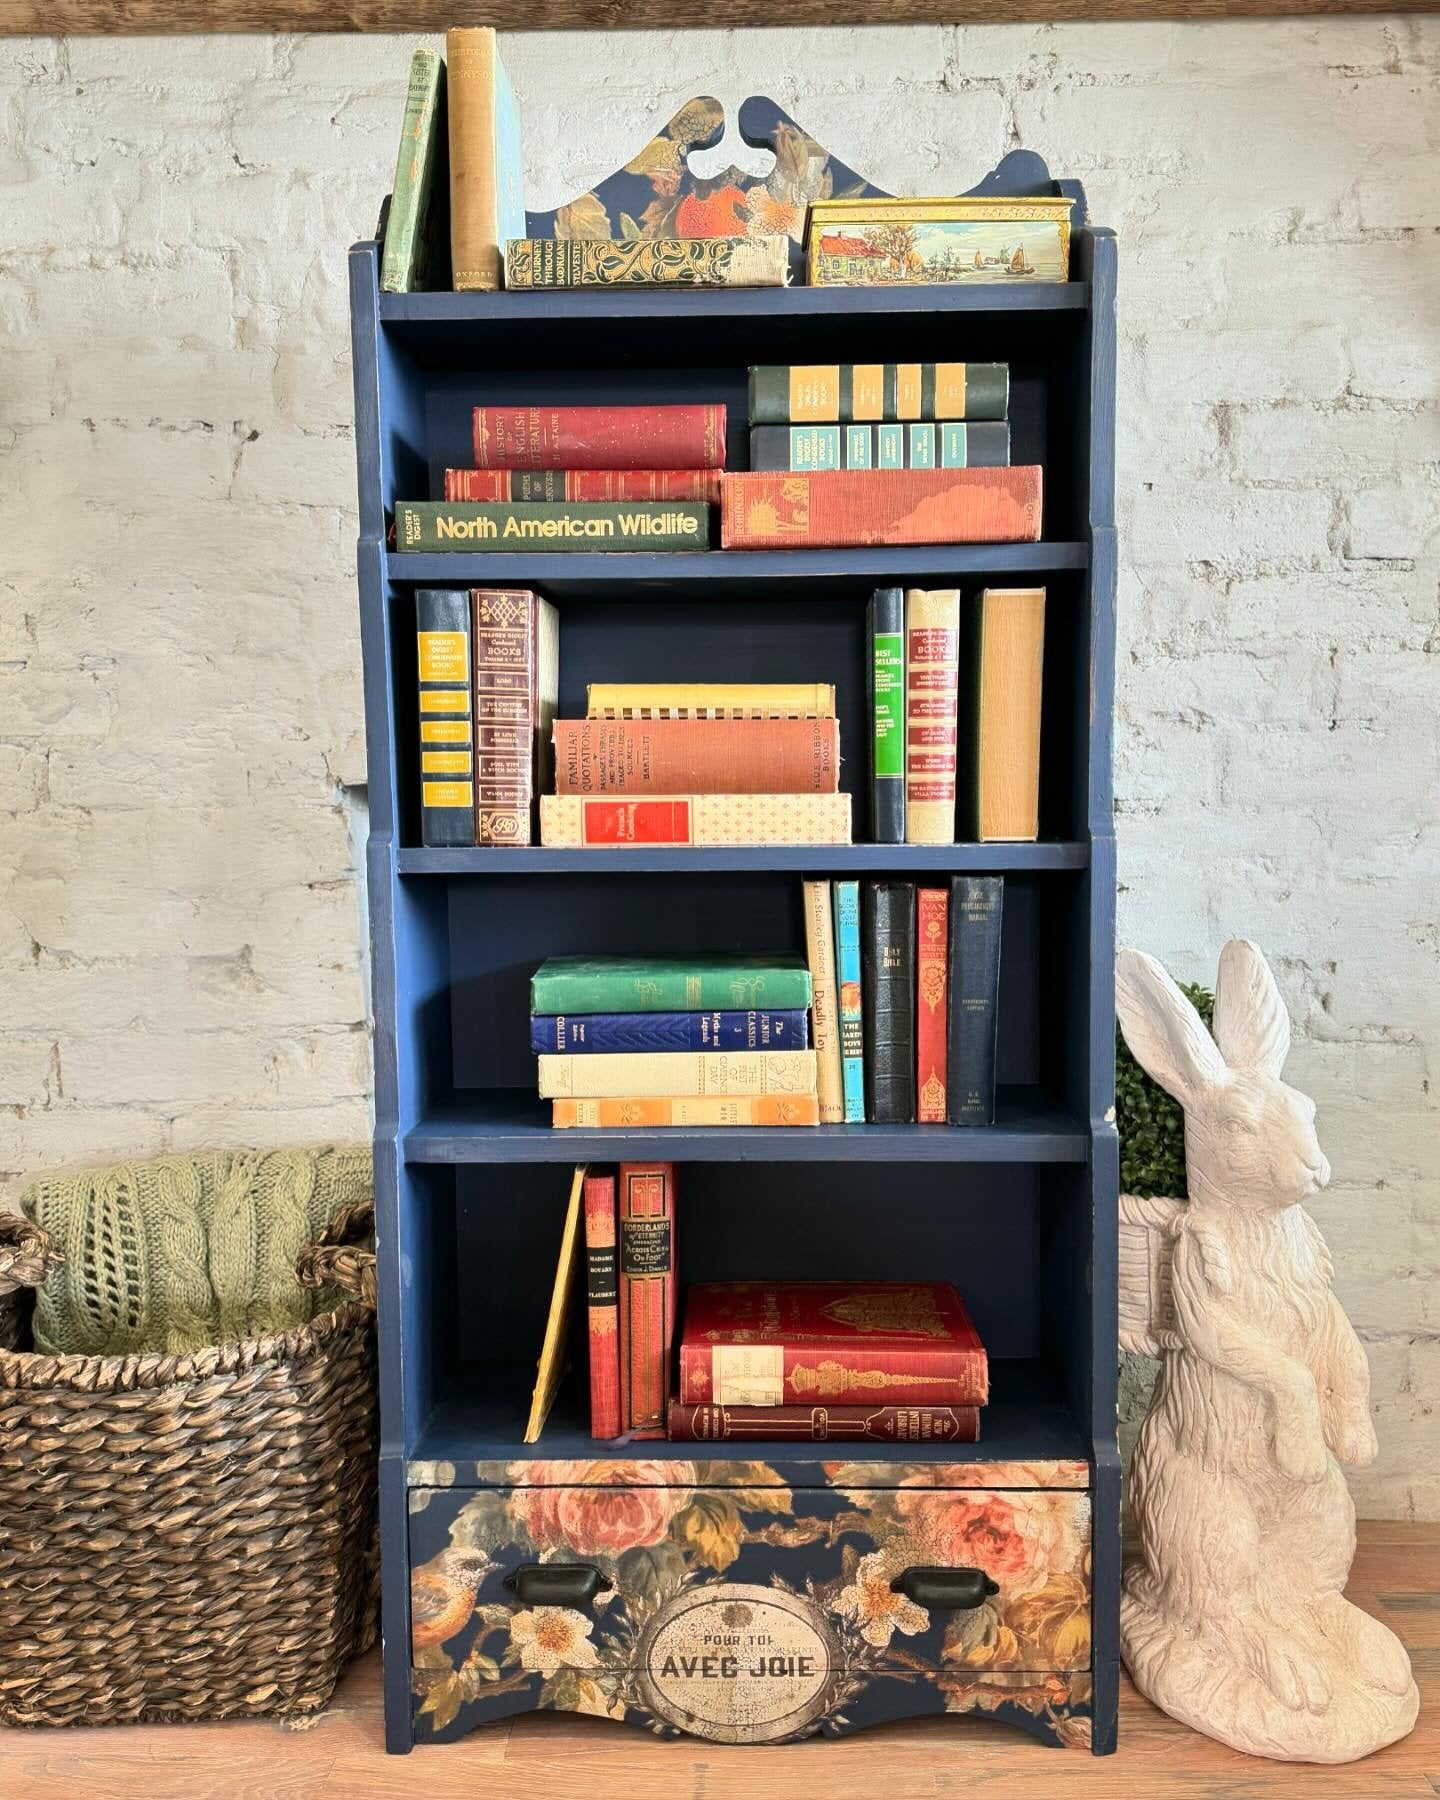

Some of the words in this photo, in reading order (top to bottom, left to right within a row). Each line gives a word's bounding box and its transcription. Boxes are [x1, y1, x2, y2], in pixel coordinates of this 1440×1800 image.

[532, 239, 545, 285] JOURNEYS
[495, 414, 505, 460] HISTORY
[514, 411, 527, 464] ENGLISH
[522, 471, 531, 500] POEMS
[533, 480, 541, 492] OF
[404, 509, 413, 545] READER'S
[413, 514, 421, 541] DIGEST
[437, 517, 497, 538] North
[503, 514, 614, 538] American
[618, 513, 698, 536] Wildlife
[487, 647, 521, 656] BOOKS
[568, 731, 578, 785] FAMILIAR
[581, 725, 593, 792] QUOTATIONS
[822, 738, 830, 772] BOOKS
[616, 807, 625, 837] French
[627, 803, 637, 841] Cooking
[814, 904, 825, 937] Stanley
[921, 903, 946, 911] IVAN
[921, 912, 946, 921] HOE
[817, 939, 827, 974] Gardner
[814, 990, 826, 1027] Deadly
[557, 1016, 566, 1050] COLLIER
[701, 1016, 711, 1043] Legends
[711, 1012, 721, 1033] Myths
[748, 1011, 756, 1048] CLASSICS
[761, 1015, 770, 1044] JUNIOR
[775, 1021, 784, 1036] The
[713, 1035, 721, 1047] and
[816, 1033, 828, 1054] Toy
[709, 1065, 719, 1085] DAY
[729, 1068, 738, 1081] OF
[738, 1065, 748, 1085] BEST
[748, 1064, 758, 1084] THE
[729, 1103, 738, 1125] LITTLE
[624, 1222, 670, 1232] BORDERLANDS
[897, 1410, 908, 1440] LIBRARY
[909, 1411, 920, 1440] INTEREST
[921, 1413, 931, 1439] HUMAN
[934, 1419, 943, 1435] NEW
[703, 1635, 740, 1646] POUR
[660, 1656, 738, 1679] AVEC
[749, 1656, 815, 1678] JOIE
